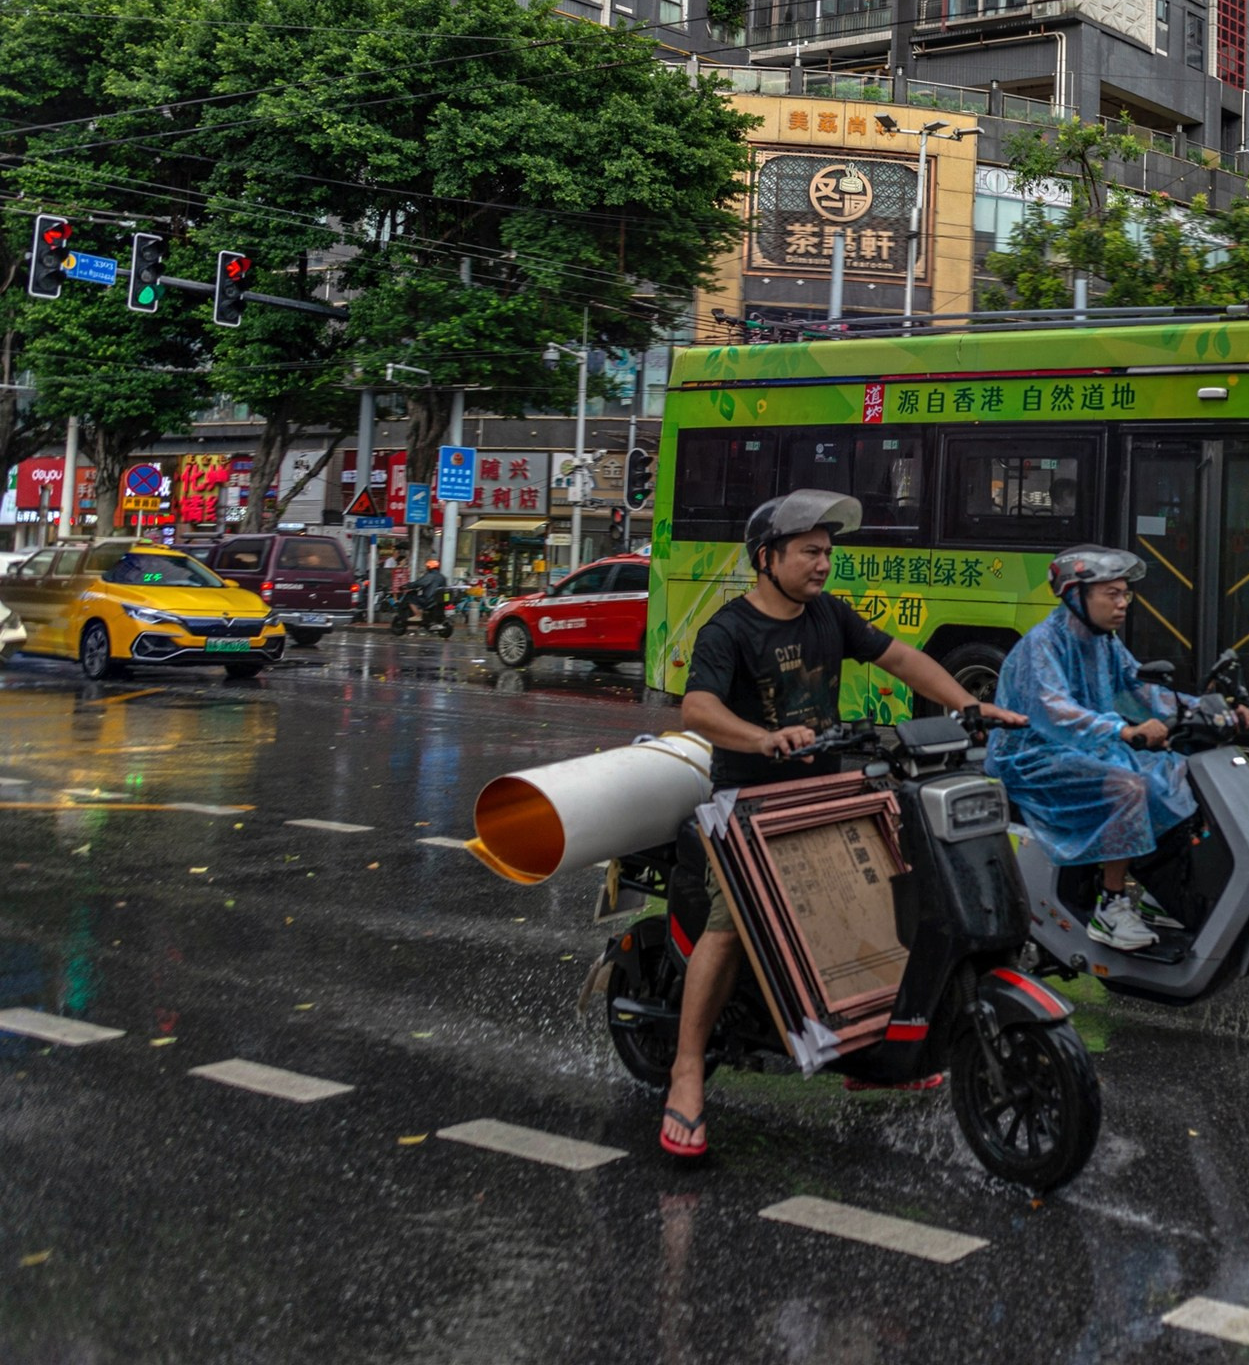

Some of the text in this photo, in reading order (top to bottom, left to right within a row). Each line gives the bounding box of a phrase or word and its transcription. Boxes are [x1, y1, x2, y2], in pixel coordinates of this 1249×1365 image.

[864, 384, 883, 422] 道地
[897, 382, 1136, 415] 源自香港 自然道地
[833, 554, 984, 588] 道地蜂蜜绿茶
[836, 594, 923, 628] 少甜
[774, 643, 802, 662] CITY
